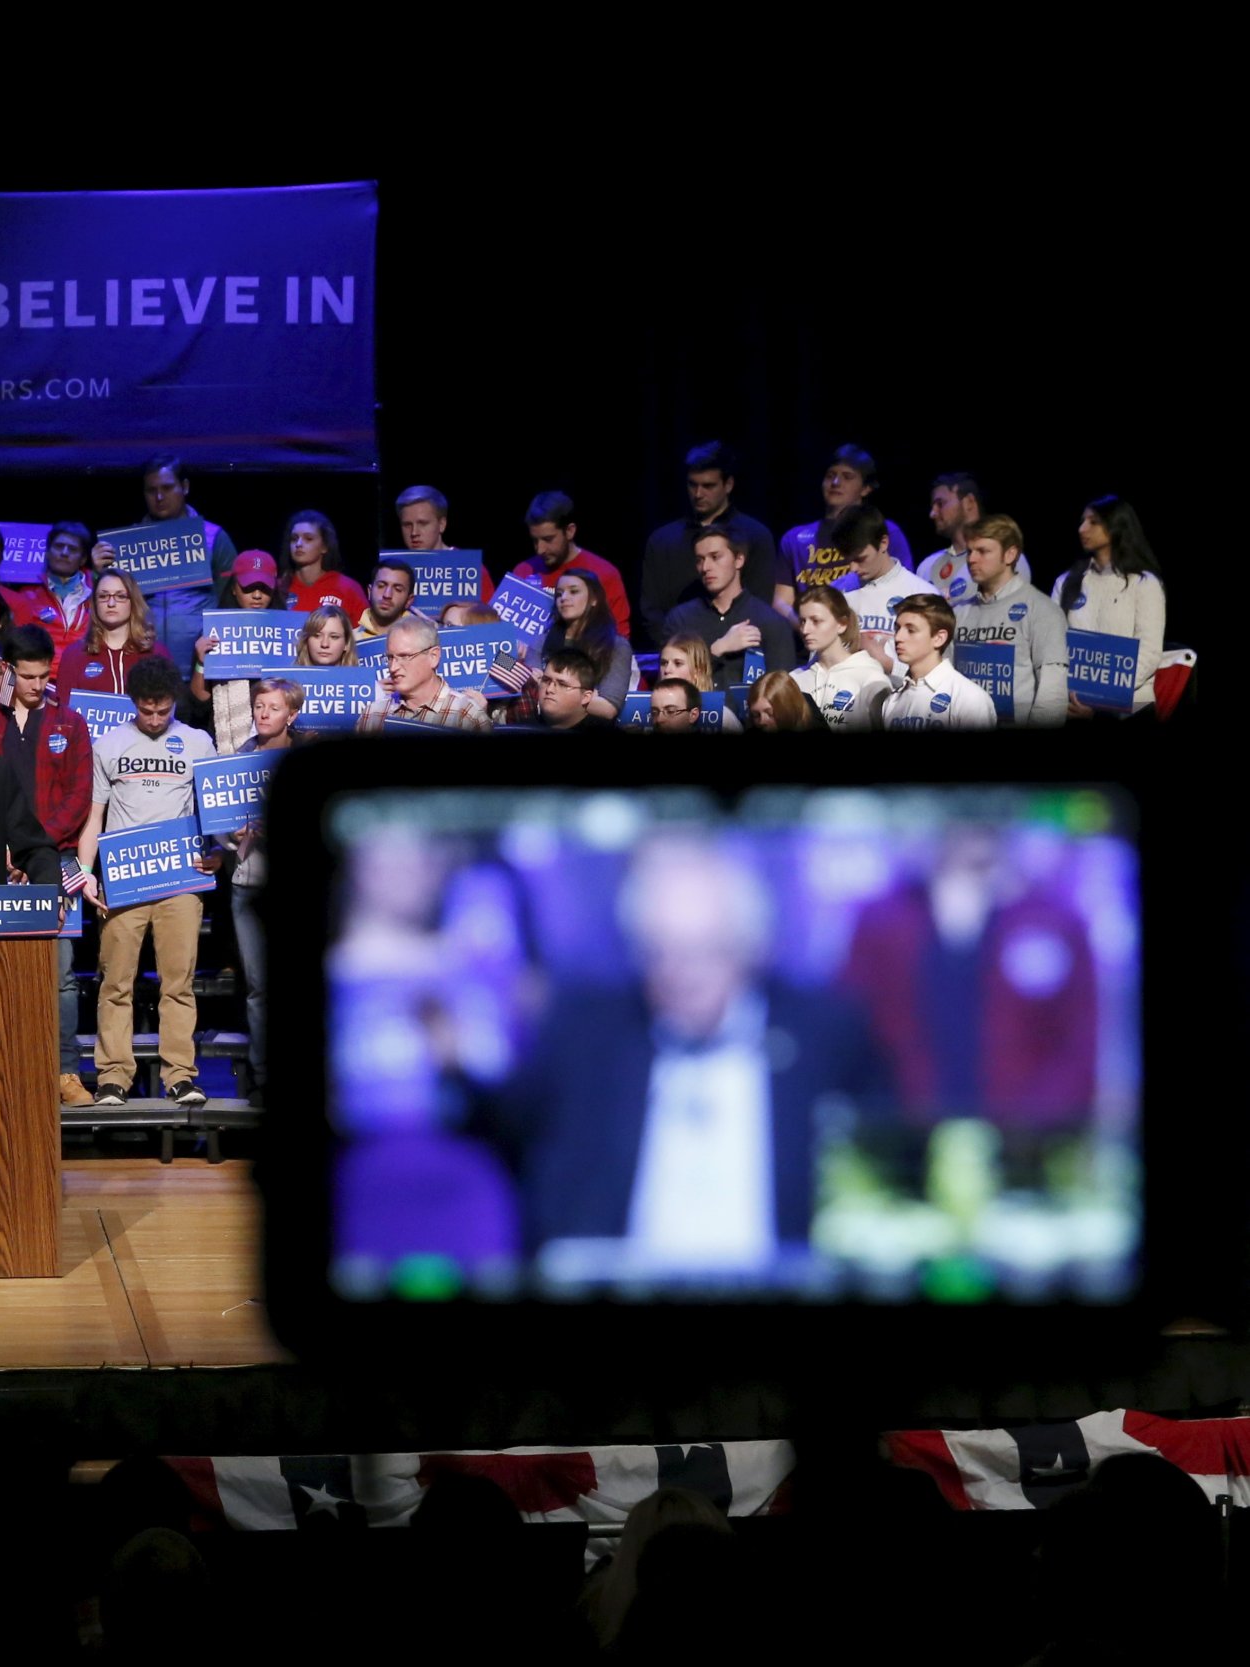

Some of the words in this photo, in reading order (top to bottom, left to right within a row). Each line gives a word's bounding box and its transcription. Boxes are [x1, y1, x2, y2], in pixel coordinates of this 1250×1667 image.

[285, 275, 355, 325] IN
[119, 537, 179, 557] FUTURE
[181, 534, 203, 547] TO
[185, 548, 206, 564] IN
[415, 567, 452, 580] TURE
[457, 567, 478, 580] TO
[457, 582, 478, 596] IN
[498, 590, 509, 604] A
[209, 627, 220, 640] A
[223, 626, 282, 640] FUTURE
[957, 622, 1016, 642] Bernie
[441, 643, 486, 659] TURE
[489, 641, 513, 656] TO
[1066, 645, 1111, 667] UTURE
[1114, 654, 1135, 671] TO
[995, 663, 1012, 678] TO
[1113, 671, 1133, 689] IN
[302, 684, 345, 698] TURE
[348, 684, 372, 698] TO
[997, 680, 1012, 697] IN
[632, 710, 642, 723] A
[701, 710, 719, 723] TO
[118, 755, 186, 775] Bernie
[141, 779, 160, 787] 2016
[202, 777, 213, 791] A
[107, 851, 117, 865] A
[119, 839, 179, 862] FUTURE
[182, 835, 204, 850] TO
[107, 854, 182, 882] BELIEVE
[35, 899, 52, 911] IN
